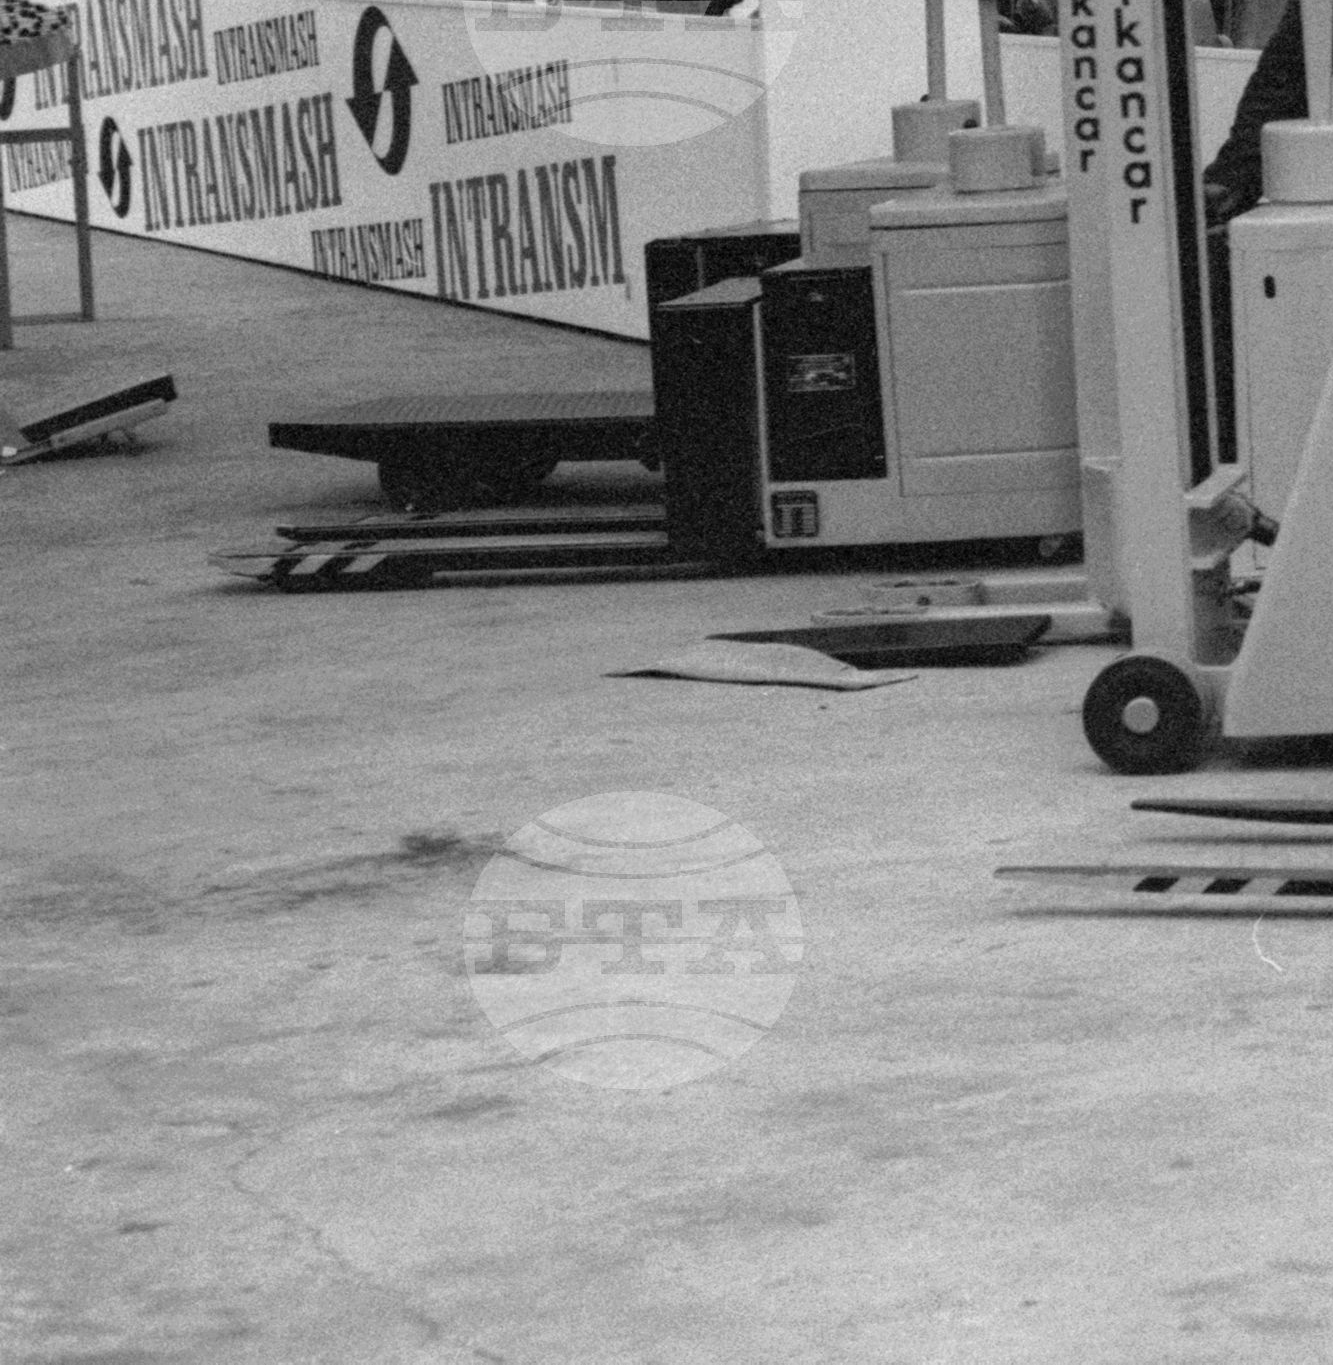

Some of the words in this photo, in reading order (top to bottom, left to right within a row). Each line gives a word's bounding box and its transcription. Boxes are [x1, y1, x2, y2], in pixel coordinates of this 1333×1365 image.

[213, 9, 320, 86] INTRANSMASH
[441, 59, 572, 144] INTRANSMASH
[137, 92, 342, 232] INTRANSMASH
[311, 218, 426, 284] INTRANSMASH
[429, 154, 627, 300] INTRANSM
